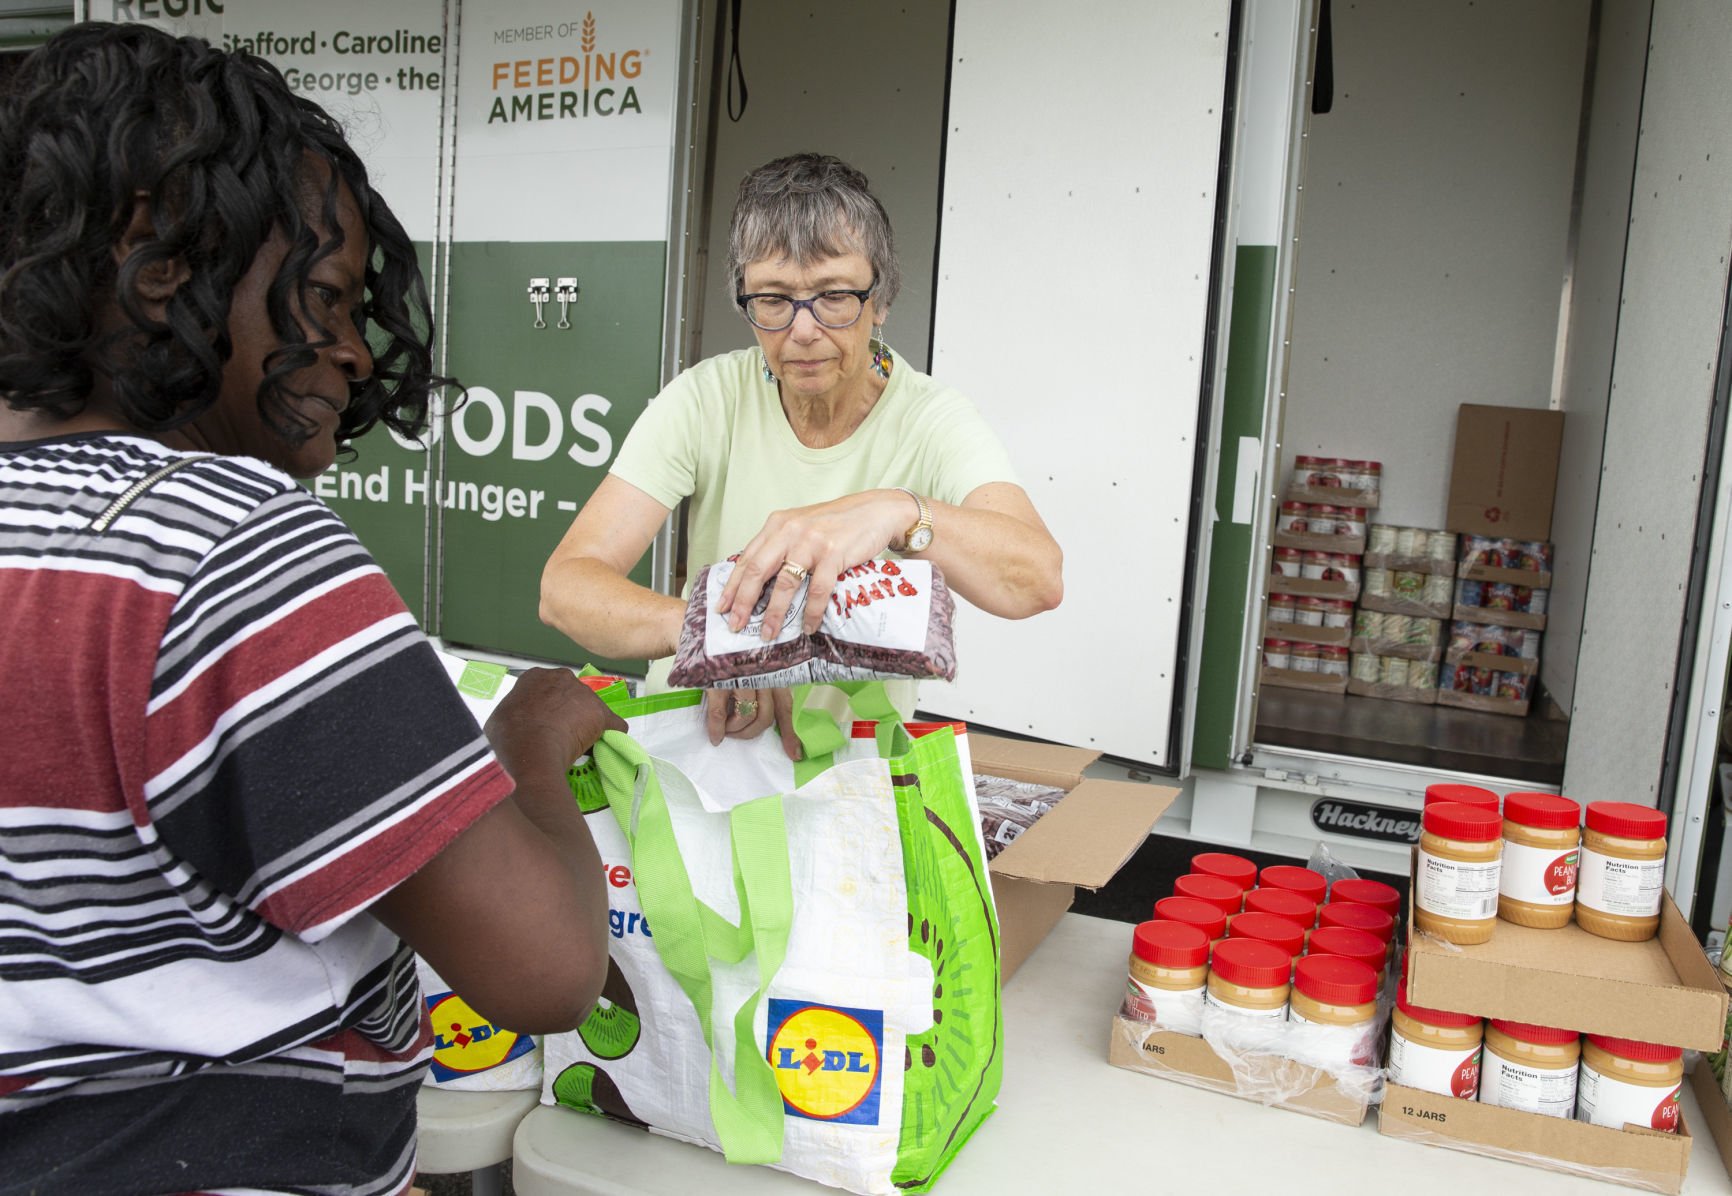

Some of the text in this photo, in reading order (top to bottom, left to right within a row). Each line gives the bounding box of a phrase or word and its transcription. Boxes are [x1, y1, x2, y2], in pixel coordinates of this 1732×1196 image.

[332, 30, 441, 55] Caroline
[494, 22, 579, 44] MEMBER OF
[284, 66, 440, 95] George the
[493, 50, 642, 90] FEEDING
[488, 86, 642, 124] AMERICA
[342, 386, 613, 468] OODS
[314, 465, 390, 503] End
[405, 468, 545, 521] Hunger
[1318, 803, 1421, 841] Hackney
[1426, 863, 1443, 873] Facts
[1427, 858, 1456, 871] Nutrition
[1605, 865, 1626, 874] Facts
[1606, 860, 1639, 870] Nutrition
[1501, 1064, 1538, 1080] Nutrition
[1501, 1070, 1523, 1082] Facts
[1401, 1106, 1447, 1123] 12 JARS
